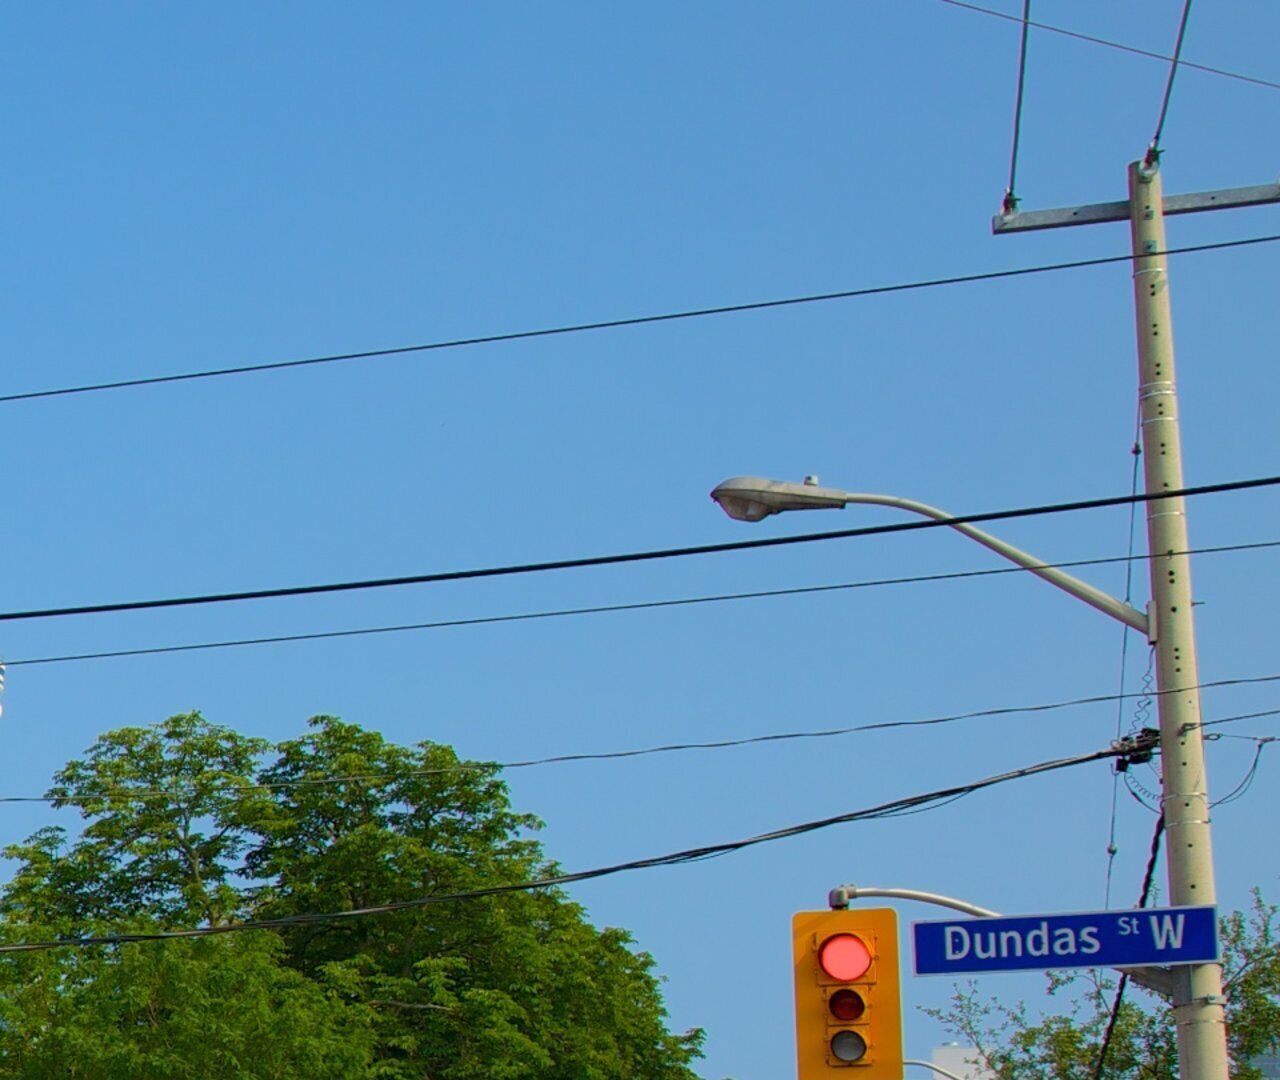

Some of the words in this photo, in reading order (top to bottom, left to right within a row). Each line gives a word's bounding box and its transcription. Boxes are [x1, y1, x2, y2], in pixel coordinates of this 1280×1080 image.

[944, 922, 1100, 961] Dundas
[1118, 916, 1139, 935] St
[1151, 915, 1185, 950] W
